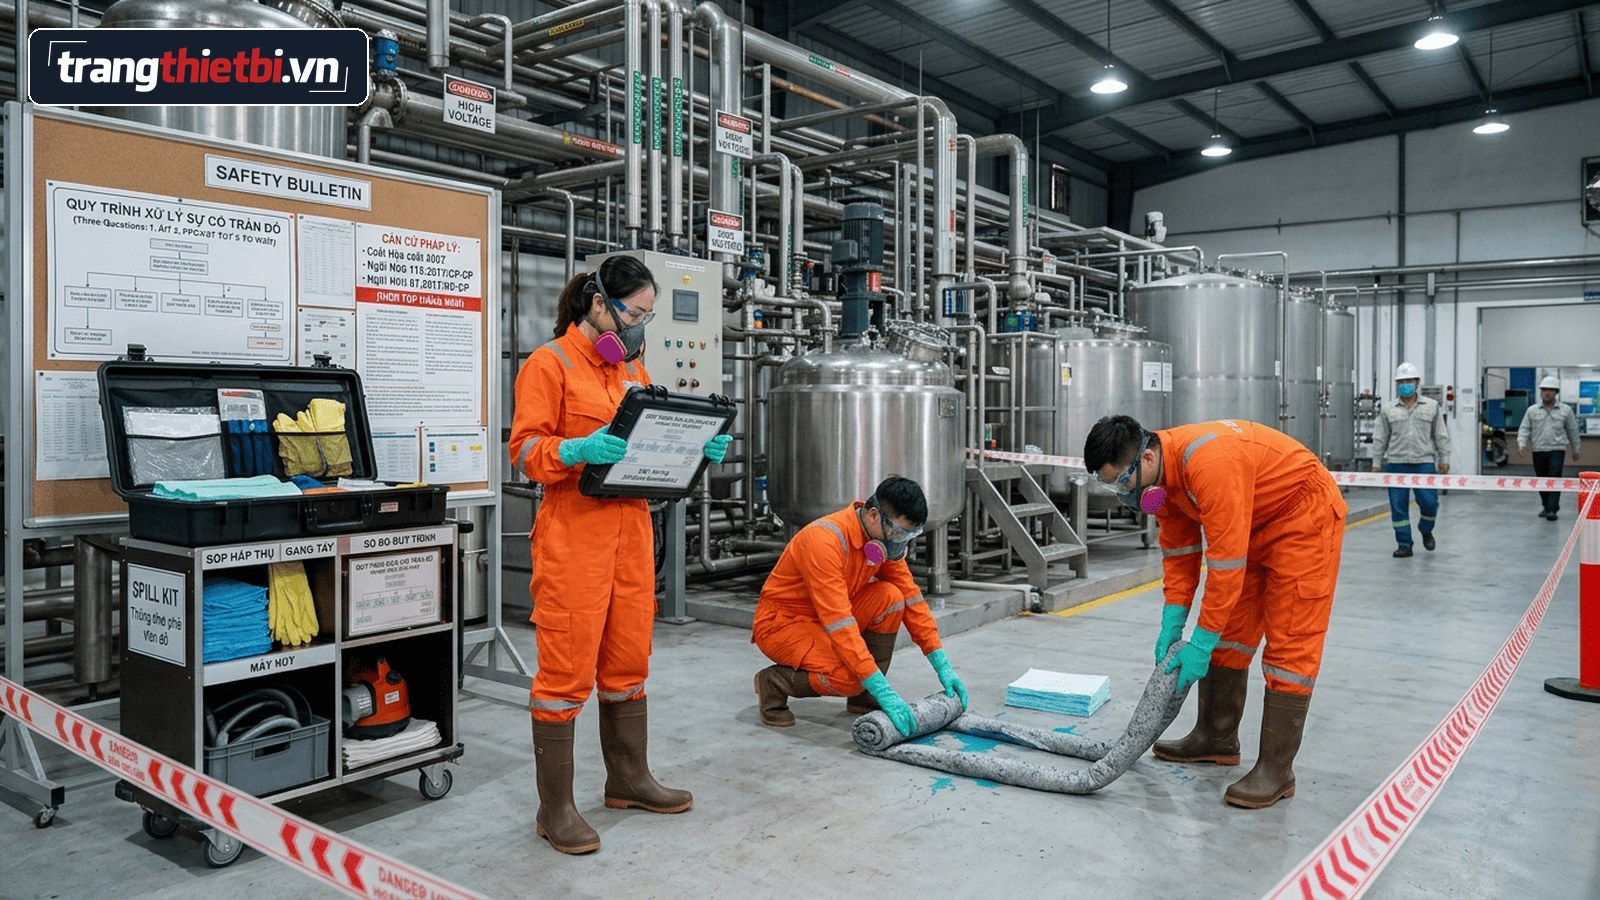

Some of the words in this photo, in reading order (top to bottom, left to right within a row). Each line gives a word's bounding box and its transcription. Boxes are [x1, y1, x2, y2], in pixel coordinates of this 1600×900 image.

[448, 109, 492, 129] VOLTAGE
[216, 165, 282, 188] SAFETY
[287, 176, 362, 201] BULLETIN
[66, 198, 97, 212] QUY
[206, 553, 228, 565] SOP
[285, 545, 314, 556] GANG
[132, 580, 160, 603] SPILL
[162, 587, 179, 607] KIT
